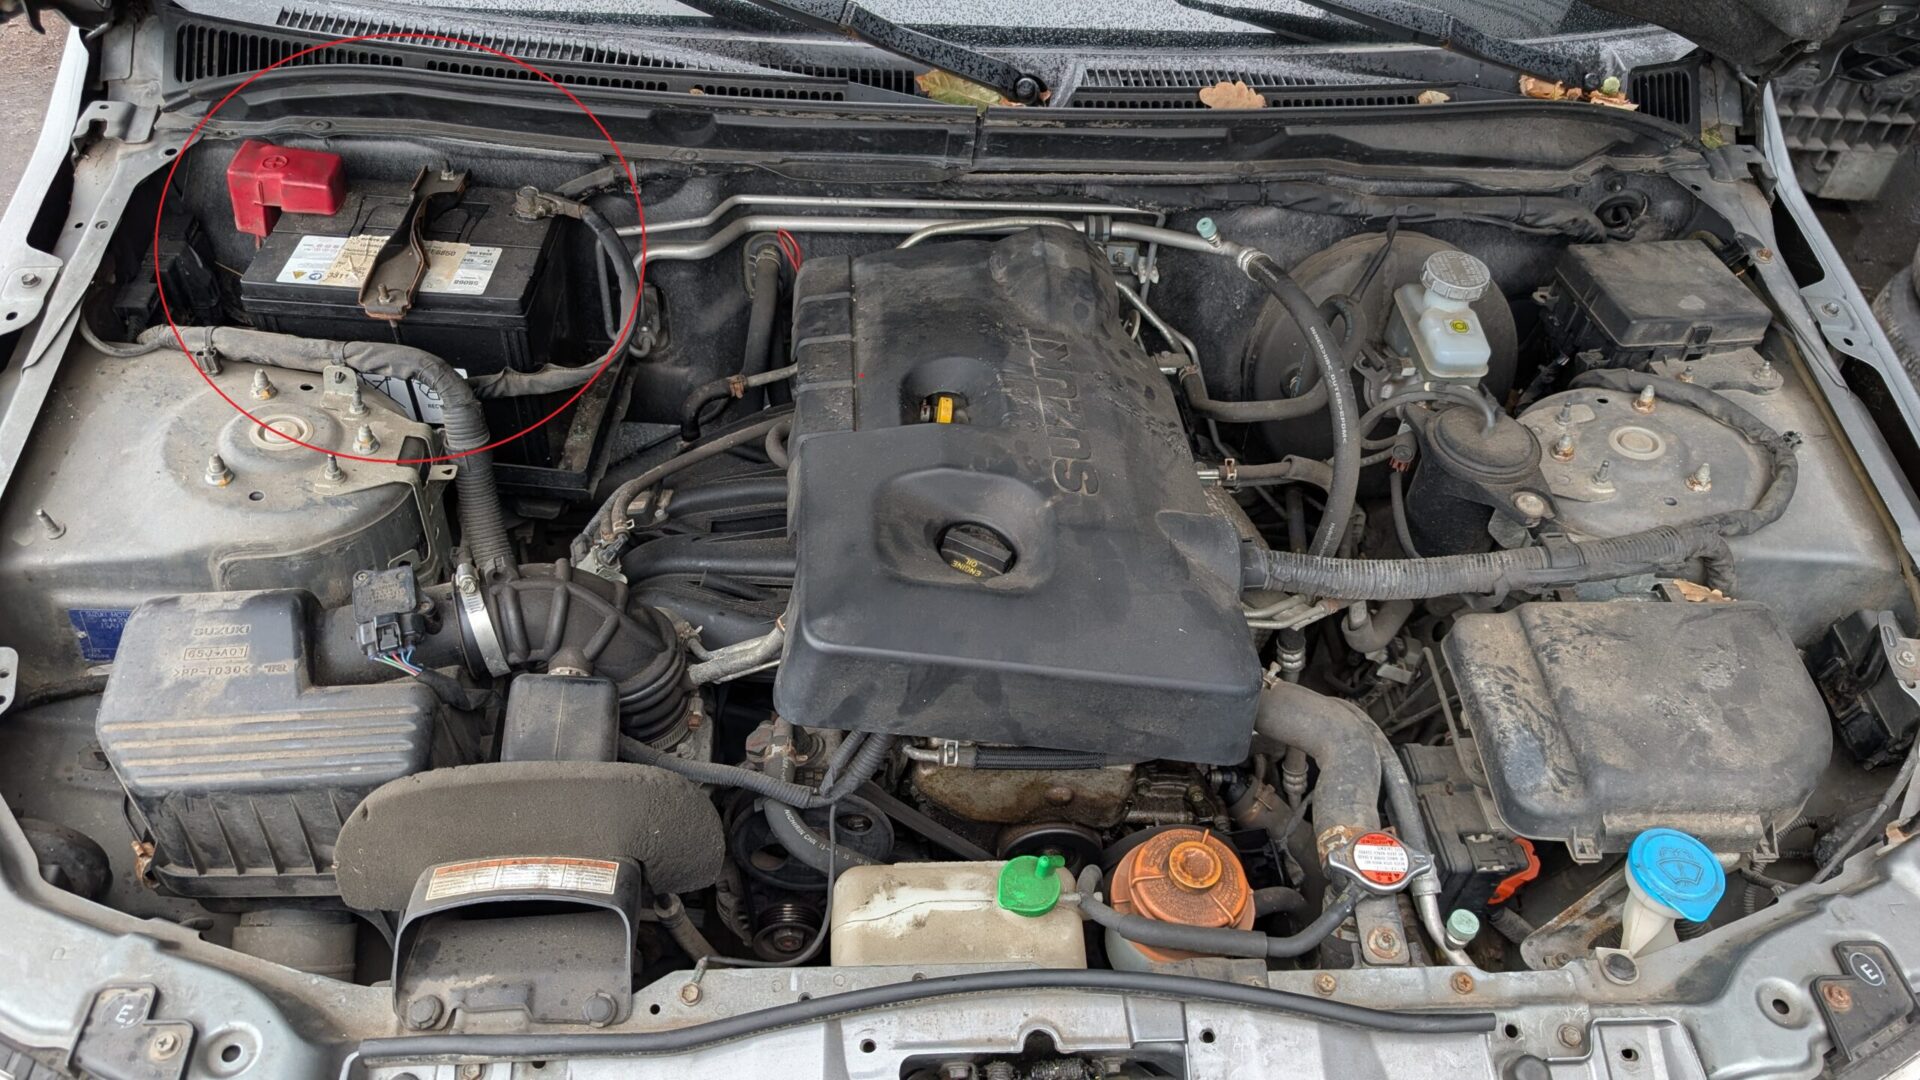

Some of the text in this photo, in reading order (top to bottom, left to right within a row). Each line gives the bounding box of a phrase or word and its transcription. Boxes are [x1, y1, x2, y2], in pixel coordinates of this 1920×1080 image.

[1024, 328, 1099, 496] SUZUKI
[951, 560, 982, 577] ENGINE
[966, 556, 978, 567] OIL
[192, 625, 251, 636] SUZUKI
